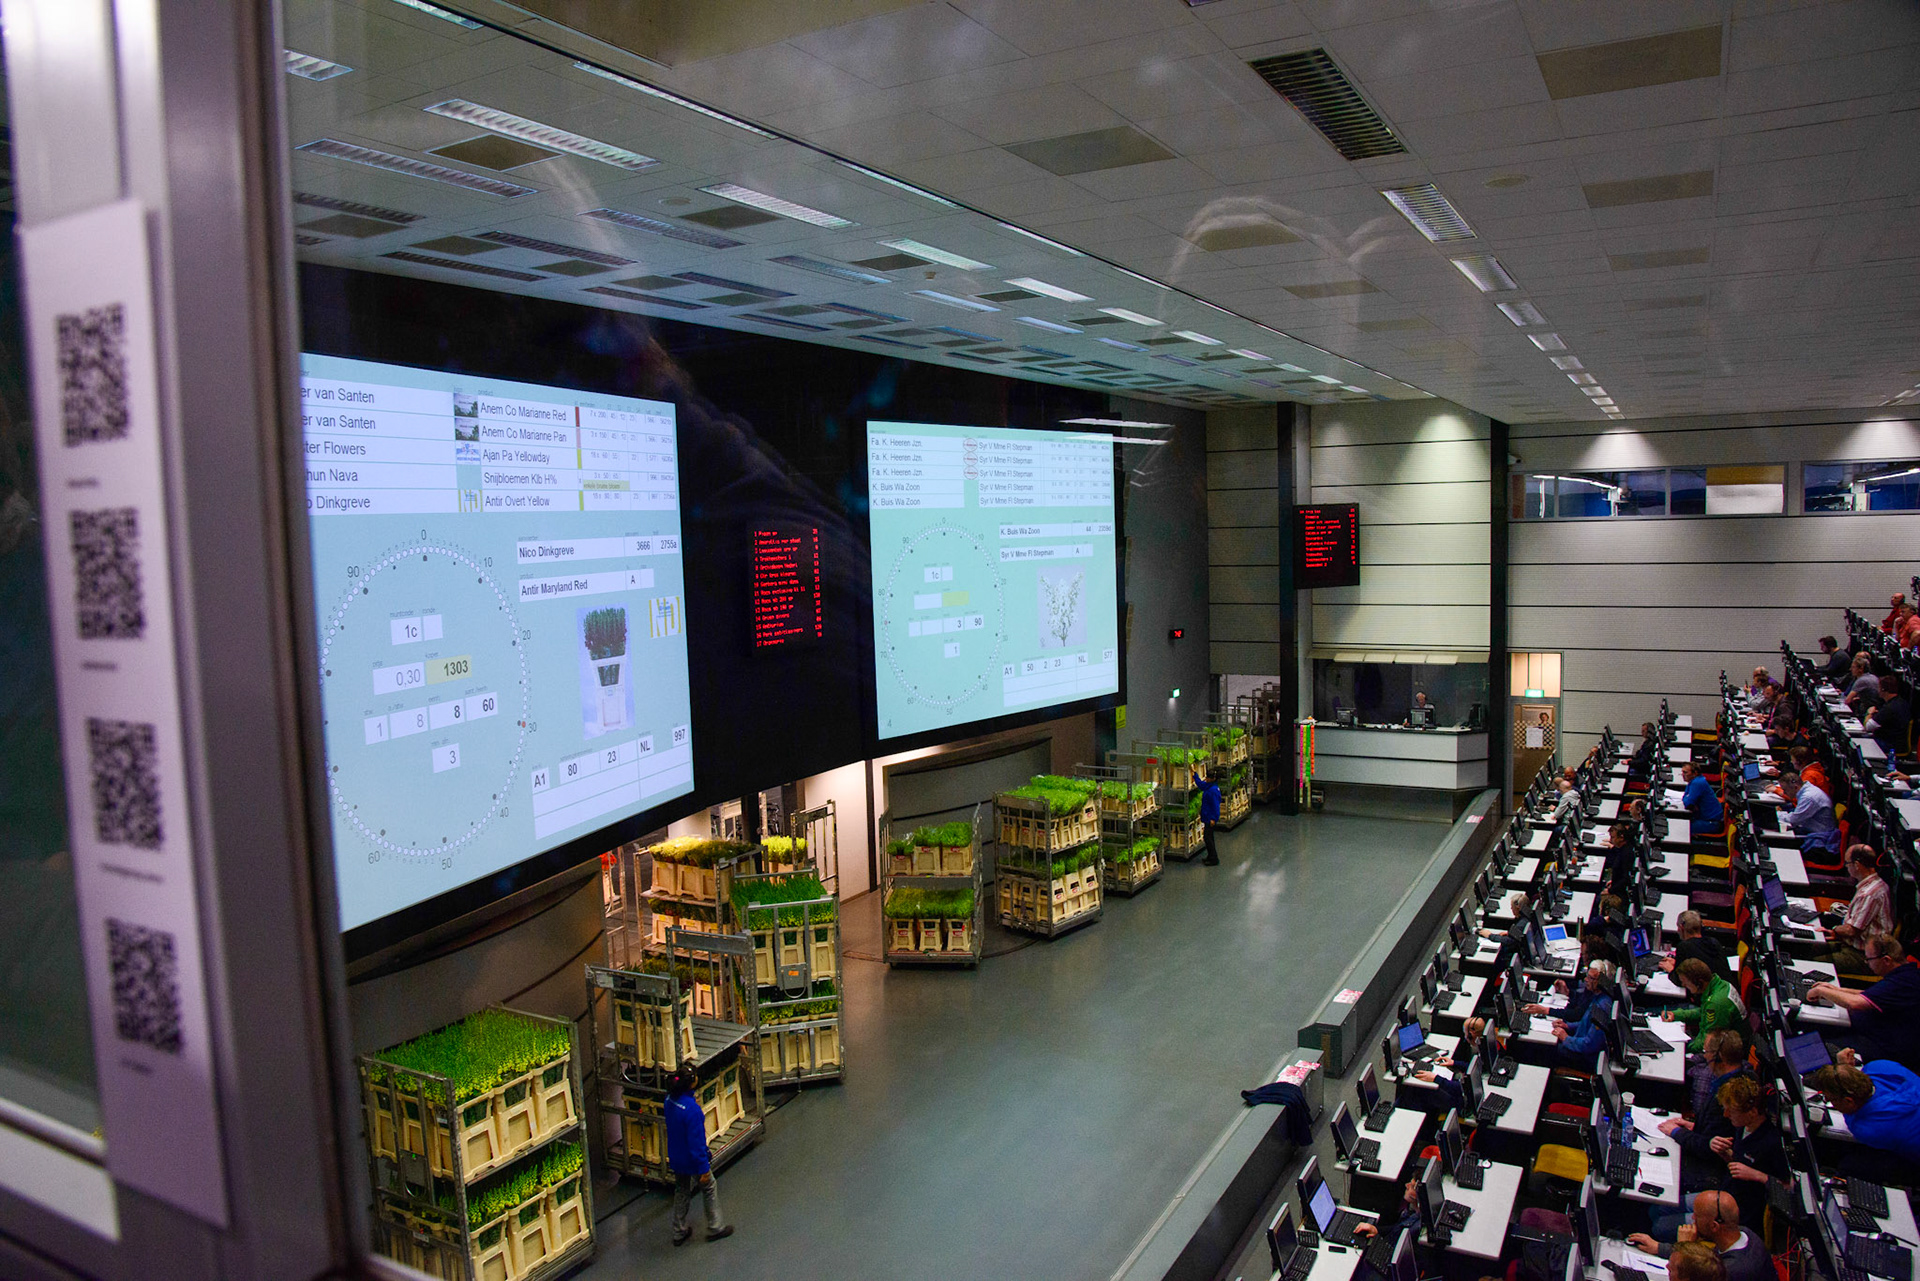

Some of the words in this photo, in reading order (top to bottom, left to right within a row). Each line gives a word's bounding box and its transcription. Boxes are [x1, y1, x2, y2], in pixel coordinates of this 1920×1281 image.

[314, 389, 334, 400] van
[338, 388, 374, 404] Santen
[480, 402, 503, 415] Anem
[506, 404, 516, 416] Co
[518, 406, 550, 419] Marianne
[553, 408, 566, 421] Red
[316, 416, 335, 428] van
[340, 415, 376, 430] Santen
[482, 426, 504, 438] Anem
[506, 428, 518, 438] Co
[520, 428, 552, 440] Marianne
[554, 430, 566, 442] Pan
[324, 441, 366, 456] Flowers
[980, 442, 988, 450] Syr
[483, 450, 500, 463] Ajan
[502, 450, 512, 461] Pa
[514, 450, 550, 465] Yellowday
[980, 456, 988, 464] Syr
[330, 469, 358, 482] Nava
[484, 473, 530, 485] Snijbloemen
[532, 474, 542, 484] Klb
[980, 470, 988, 478] Syr
[1014, 471, 1033, 479] Stepman
[980, 484, 988, 492] Syr
[1014, 484, 1034, 492] Stepman
[316, 496, 370, 511] Dinkgreve
[485, 496, 503, 507] Antir
[505, 496, 526, 506] Overt
[528, 494, 550, 506] Yellow
[881, 498, 894, 506] Buis
[980, 497, 988, 505] Syr
[1014, 497, 1034, 505] Stepman
[421, 530, 426, 540] 0
[636, 541, 650, 550] 3666
[661, 540, 677, 550] 2755a
[520, 547, 536, 558] Nico
[538, 546, 574, 558] Dinkgreve
[1034, 549, 1054, 557] Stepman
[484, 556, 492, 568] 10
[347, 566, 360, 578] 90
[932, 570, 940, 580] 1c
[631, 575, 636, 584] A
[522, 585, 538, 596] Antir
[541, 582, 572, 595] Maryland
[574, 580, 588, 590] Red
[957, 620, 962, 628] 3
[974, 618, 982, 626] 90
[405, 624, 418, 638] 1c
[522, 630, 531, 640] 20
[444, 660, 468, 676] 1303
[1054, 659, 1061, 668] 23
[396, 668, 420, 687] 0,30
[1004, 667, 1013, 676] A1
[482, 698, 494, 712] 60
[454, 705, 460, 718] 8
[417, 714, 424, 728] 8
[528, 722, 537, 732] 30
[377, 723, 382, 736] 1
[674, 729, 686, 741] 997
[640, 742, 650, 752] NL
[450, 750, 456, 764] 3
[608, 751, 616, 763] 23
[568, 763, 578, 776] 80
[534, 774, 546, 788] A1
[500, 807, 509, 818] 40
[368, 851, 380, 864] 60
[442, 858, 452, 870] 50
